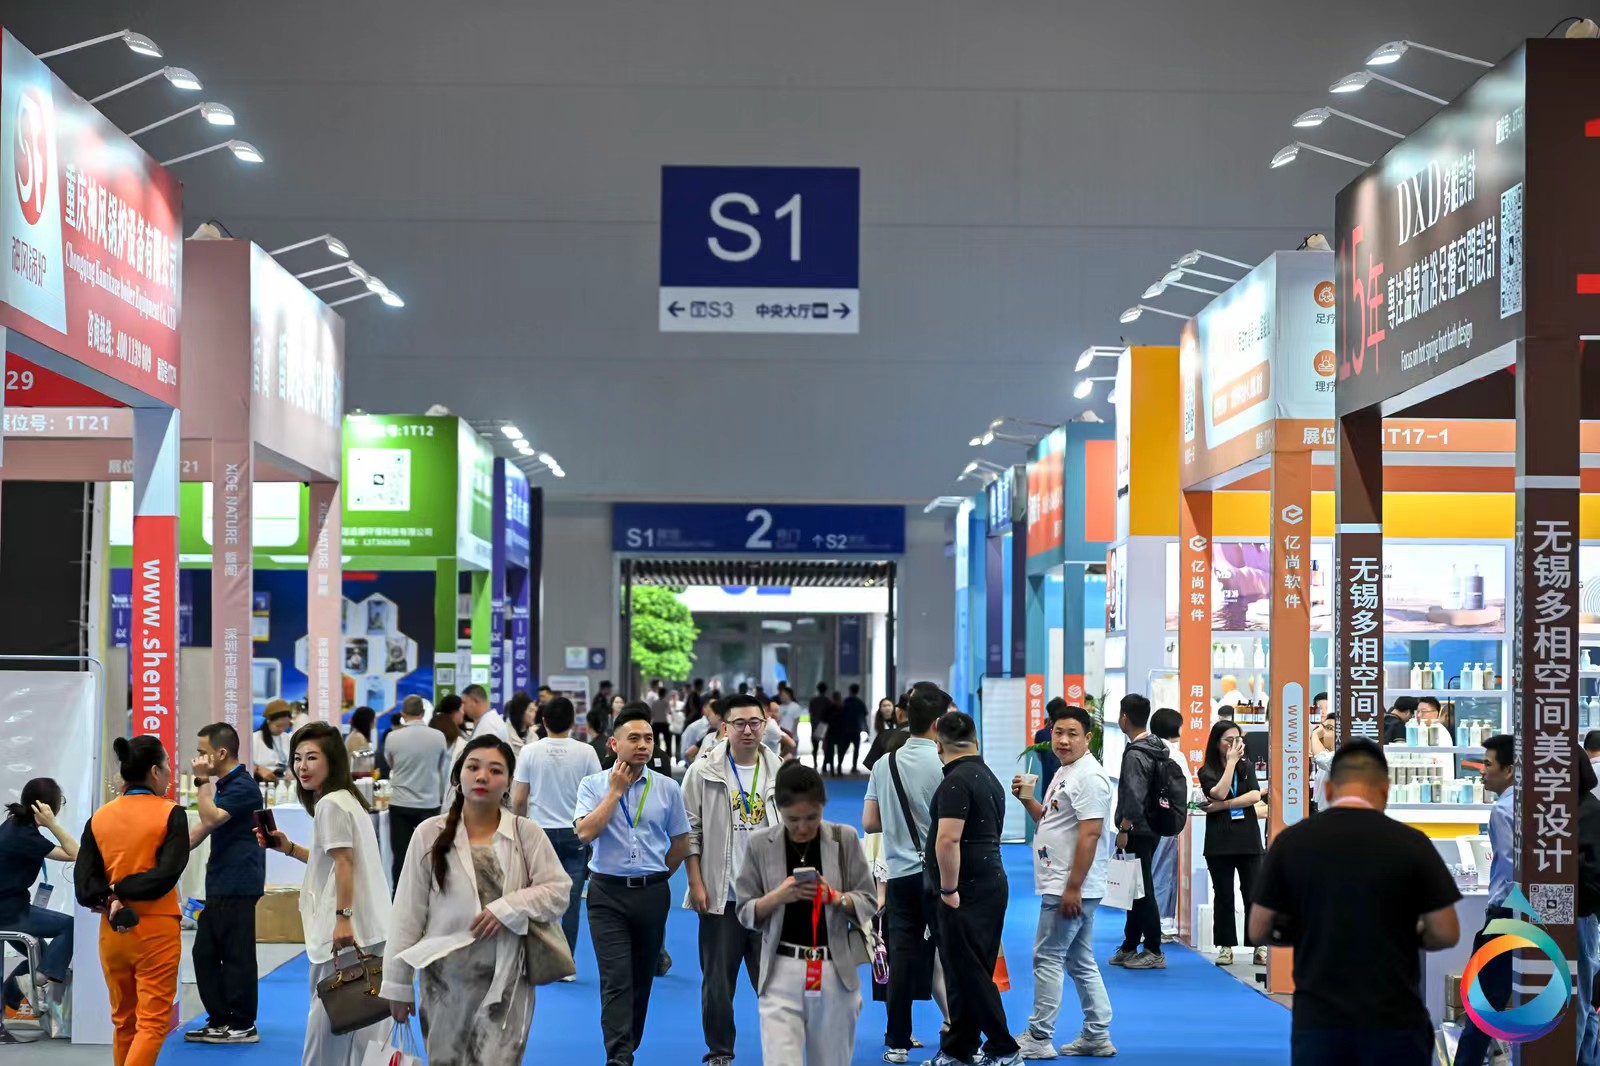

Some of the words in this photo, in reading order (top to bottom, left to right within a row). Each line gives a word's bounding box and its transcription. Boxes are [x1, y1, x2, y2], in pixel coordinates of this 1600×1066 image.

[1396, 159, 1441, 246] DXD
[65, 163, 177, 295] 重庆神风锅炉设备有限公司
[707, 191, 802, 263] S1
[11, 235, 47, 288] 神风锅炉
[708, 301, 734, 318] S3
[755, 302, 812, 319] 中央大厅
[1315, 313, 1335, 325] 足疗
[116, 330, 128, 360] 400
[5, 370, 34, 391] 29
[1315, 380, 1335, 393] 理疗
[225, 463, 238, 491] XIGE
[225, 495, 238, 545] NATURE
[626, 527, 654, 548] S1
[744, 507, 773, 549] 2
[825, 533, 848, 550] S2
[1190, 560, 1206, 622] 亿尚软件
[1284, 534, 1301, 609] 亿尚软件
[1532, 518, 1573, 874] 无锡多相空间美学设计
[1284, 704, 1302, 805] www.jete.cn
